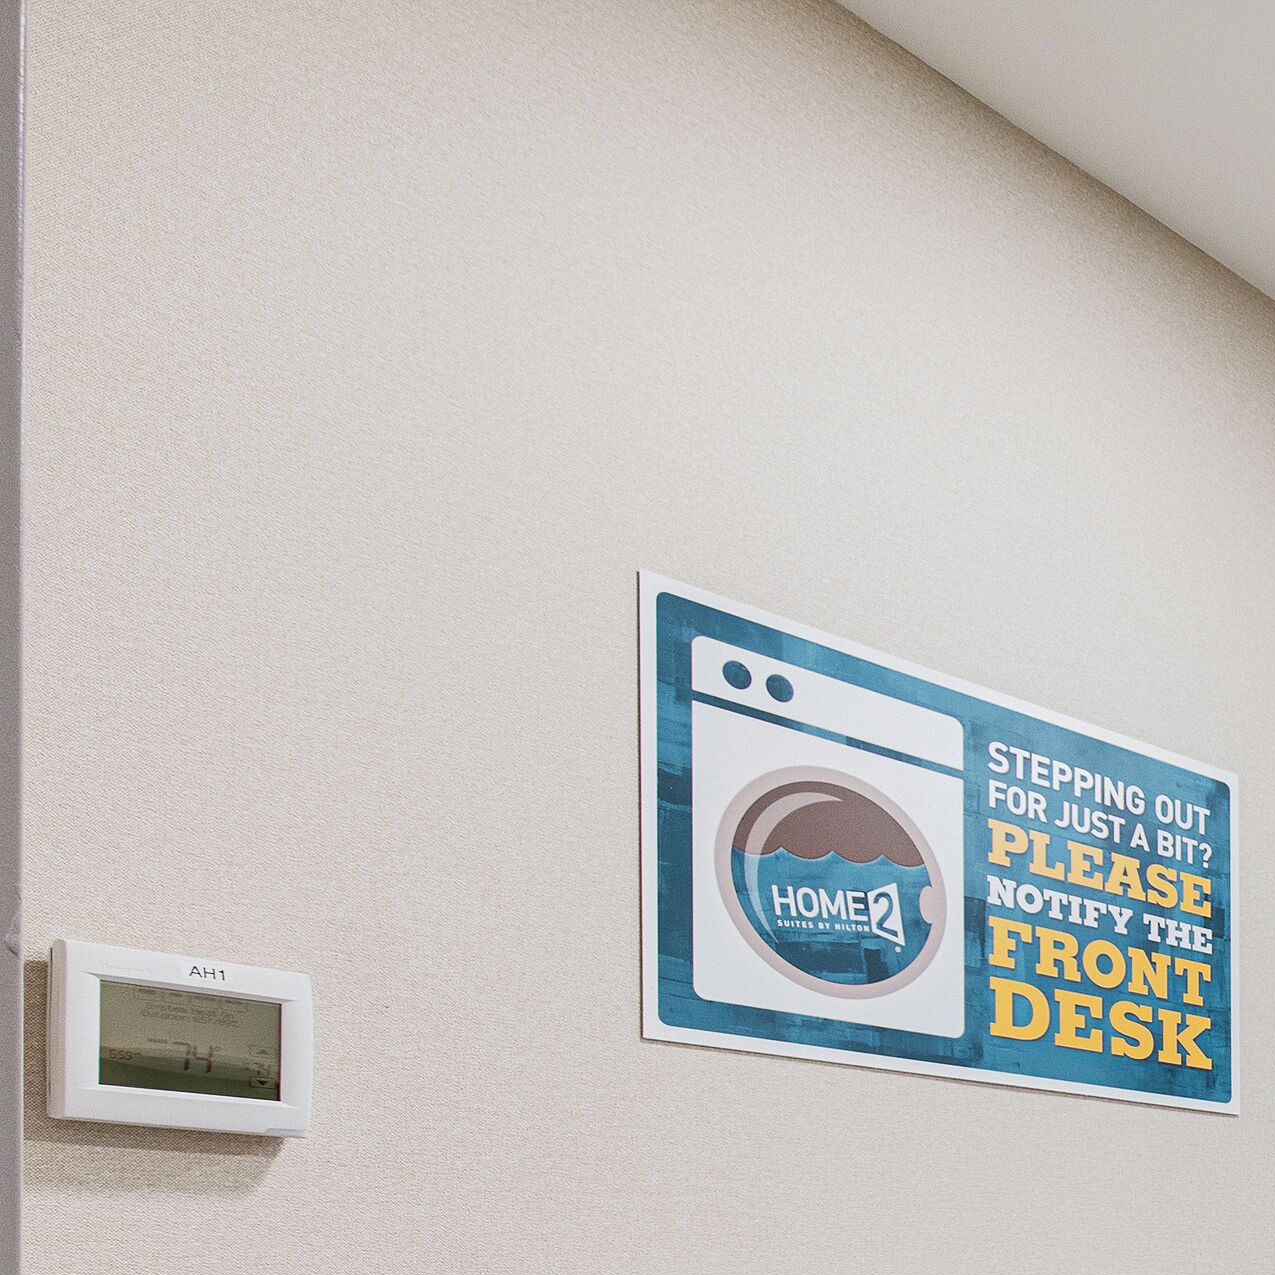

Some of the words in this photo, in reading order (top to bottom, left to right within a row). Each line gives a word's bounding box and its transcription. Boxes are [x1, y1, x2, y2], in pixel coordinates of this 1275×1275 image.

[987, 742, 1146, 816] STEPPING
[1155, 794, 1211, 835] OUT
[988, 779, 1048, 823] FOR
[1054, 801, 1126, 844] JUST
[1130, 823, 1150, 852] A
[1157, 829, 1213, 869] BIT?
[987, 818, 1212, 918] PLEASE
[777, 920, 814, 929] SUITES
[834, 923, 871, 932] HILTON
[986, 875, 1134, 935] NOTIFY
[1143, 913, 1213, 954] THE
[189, 966, 226, 981] AH1
[988, 916, 1212, 1006] FRONT
[989, 976, 1213, 1070] DESK
